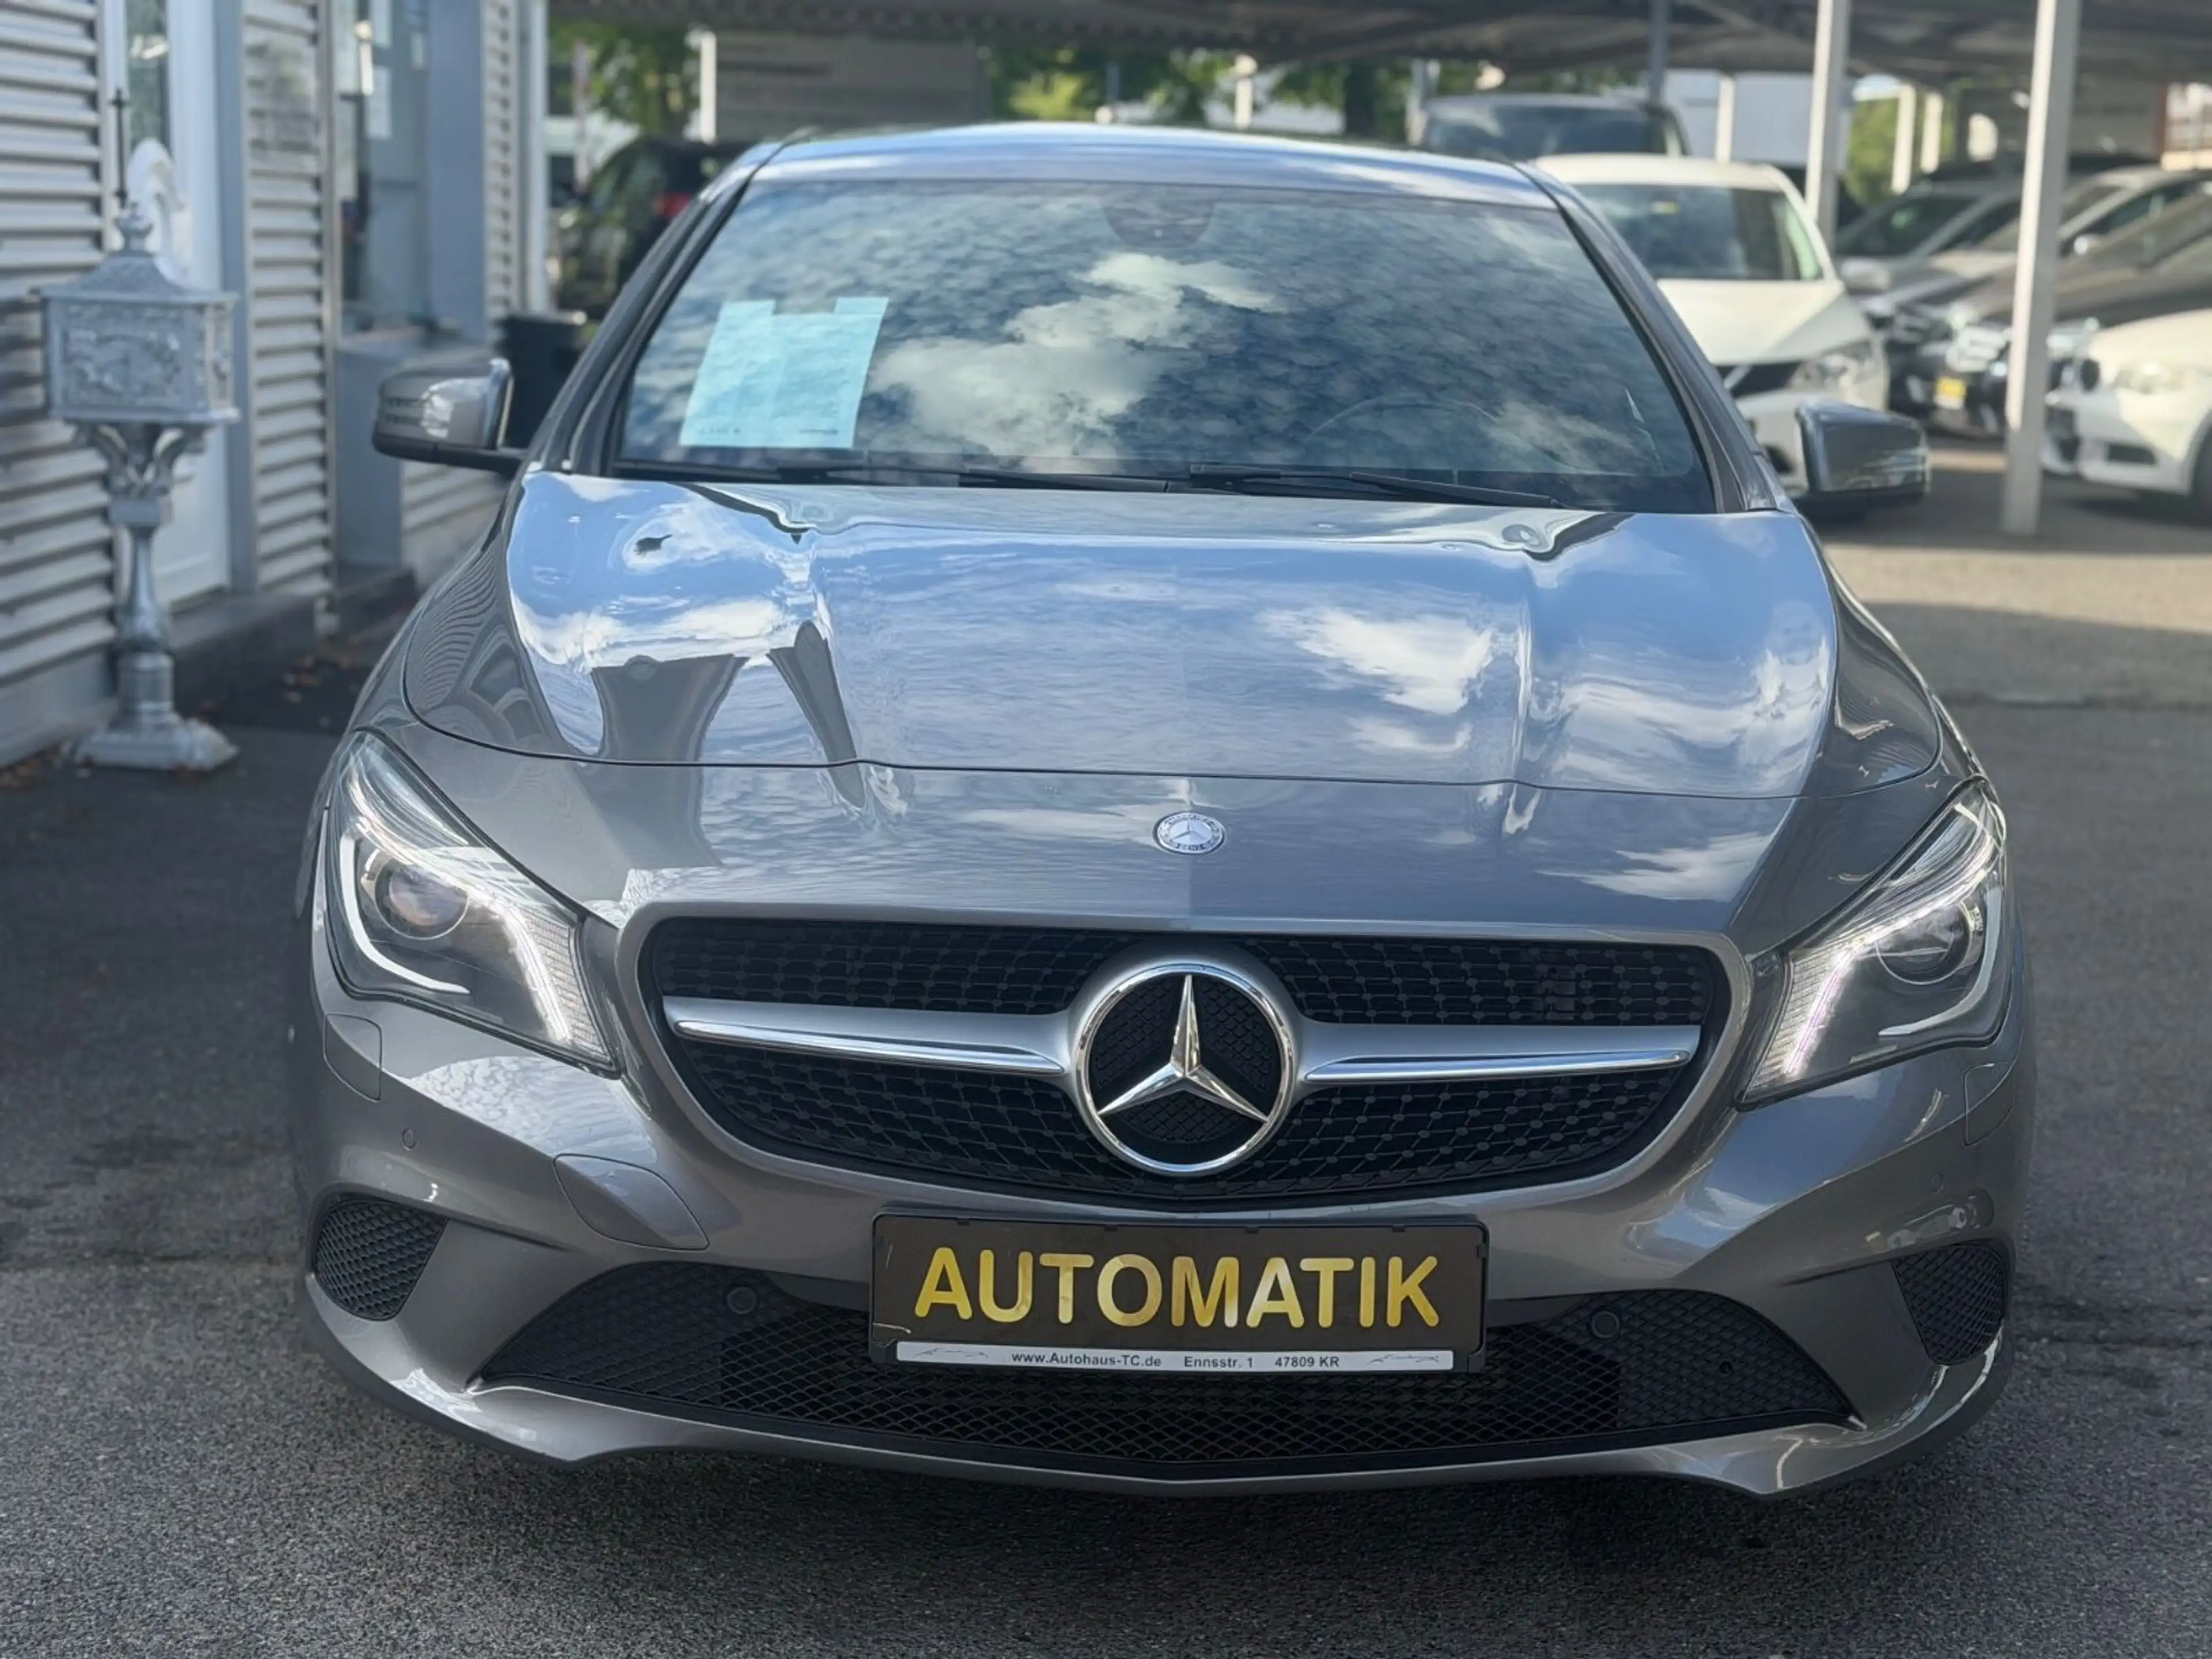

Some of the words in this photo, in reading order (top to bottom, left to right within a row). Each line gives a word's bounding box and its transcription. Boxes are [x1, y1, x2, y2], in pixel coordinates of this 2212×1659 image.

[915, 1247, 1439, 1328] AUTOMATIK
[1012, 1351, 1161, 1368] www.Autohaus-TC.de
[1184, 1356, 1242, 1368] Ennsstr.
[1247, 1356, 1253, 1368] 1
[1274, 1356, 1315, 1368] 47809
[1319, 1356, 1339, 1368] KR
